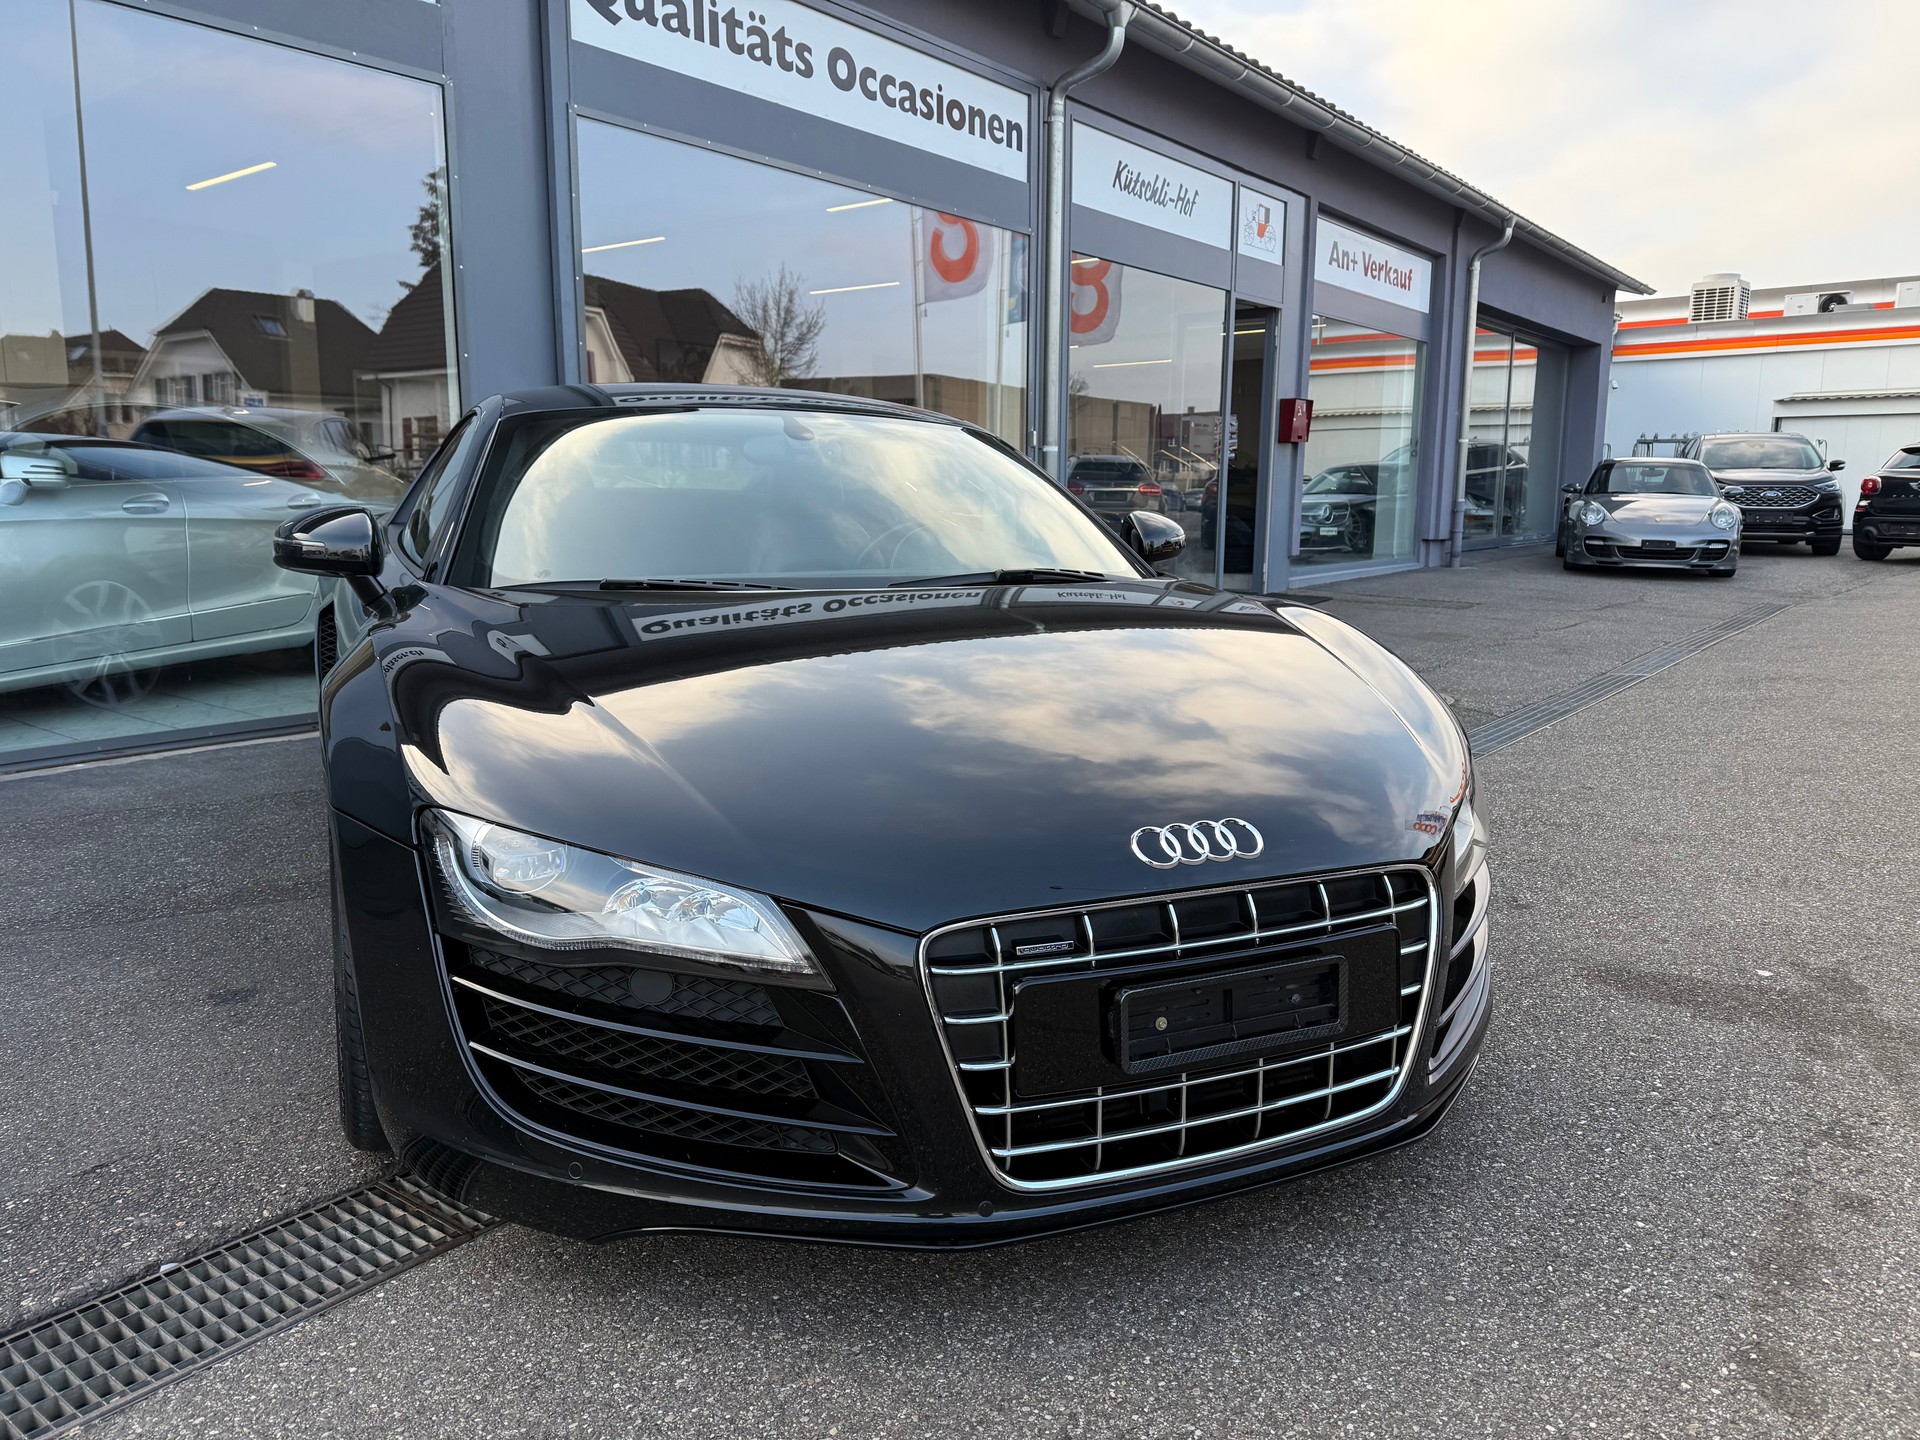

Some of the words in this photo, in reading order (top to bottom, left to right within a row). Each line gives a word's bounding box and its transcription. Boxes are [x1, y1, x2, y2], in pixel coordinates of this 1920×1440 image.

[827, 46, 1024, 153] Occasionen
[1112, 160, 1199, 218] Kütschli-Hof
[1328, 240, 1359, 272] An+
[1361, 251, 1413, 291] Verkauf
